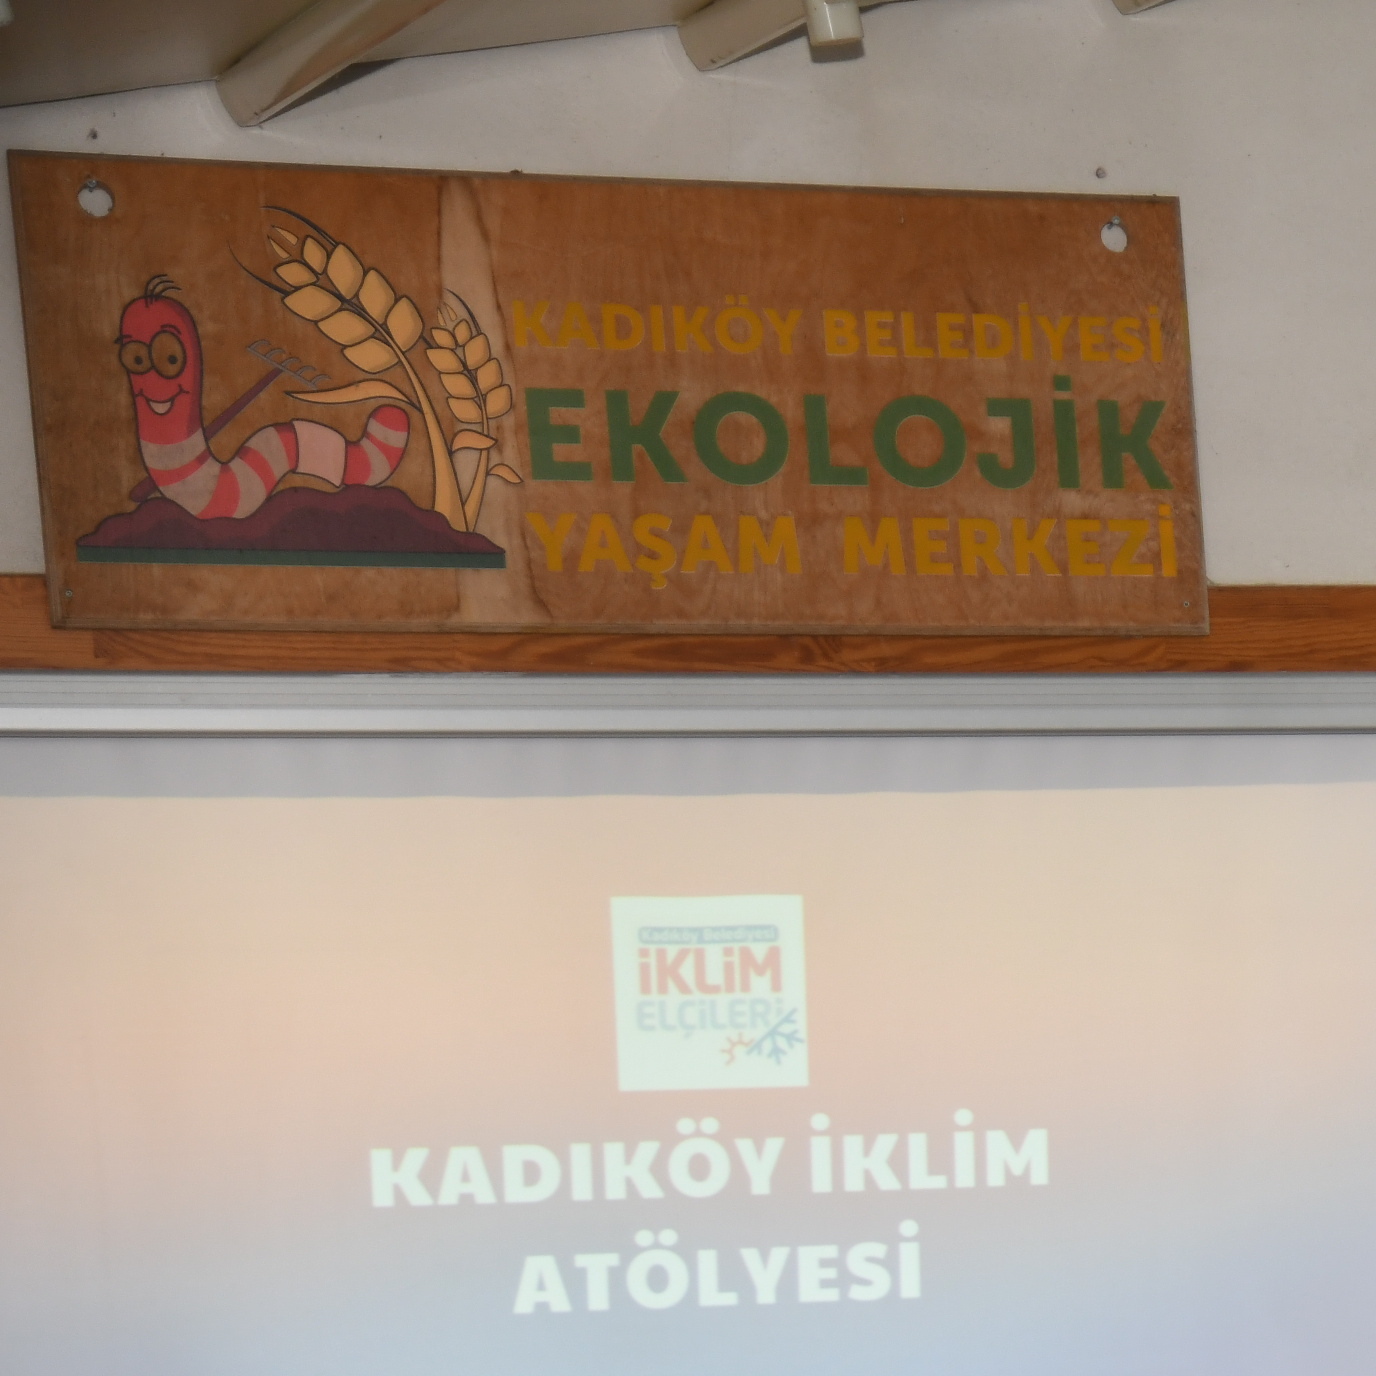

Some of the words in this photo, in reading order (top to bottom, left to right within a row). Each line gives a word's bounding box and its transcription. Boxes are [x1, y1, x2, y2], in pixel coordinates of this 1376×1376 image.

[512, 295, 800, 354] KADIKÖY
[822, 302, 1164, 363] BELEDİYESİ
[524, 375, 1174, 490] EKOLOJİK
[525, 512, 801, 590] YAŞAM
[843, 504, 1178, 578] MERKEZİ
[369, 1116, 785, 1207] KADIKÖY
[809, 1108, 1050, 1193] İKLİM
[512, 1219, 922, 1314] ATÖLYESİ
